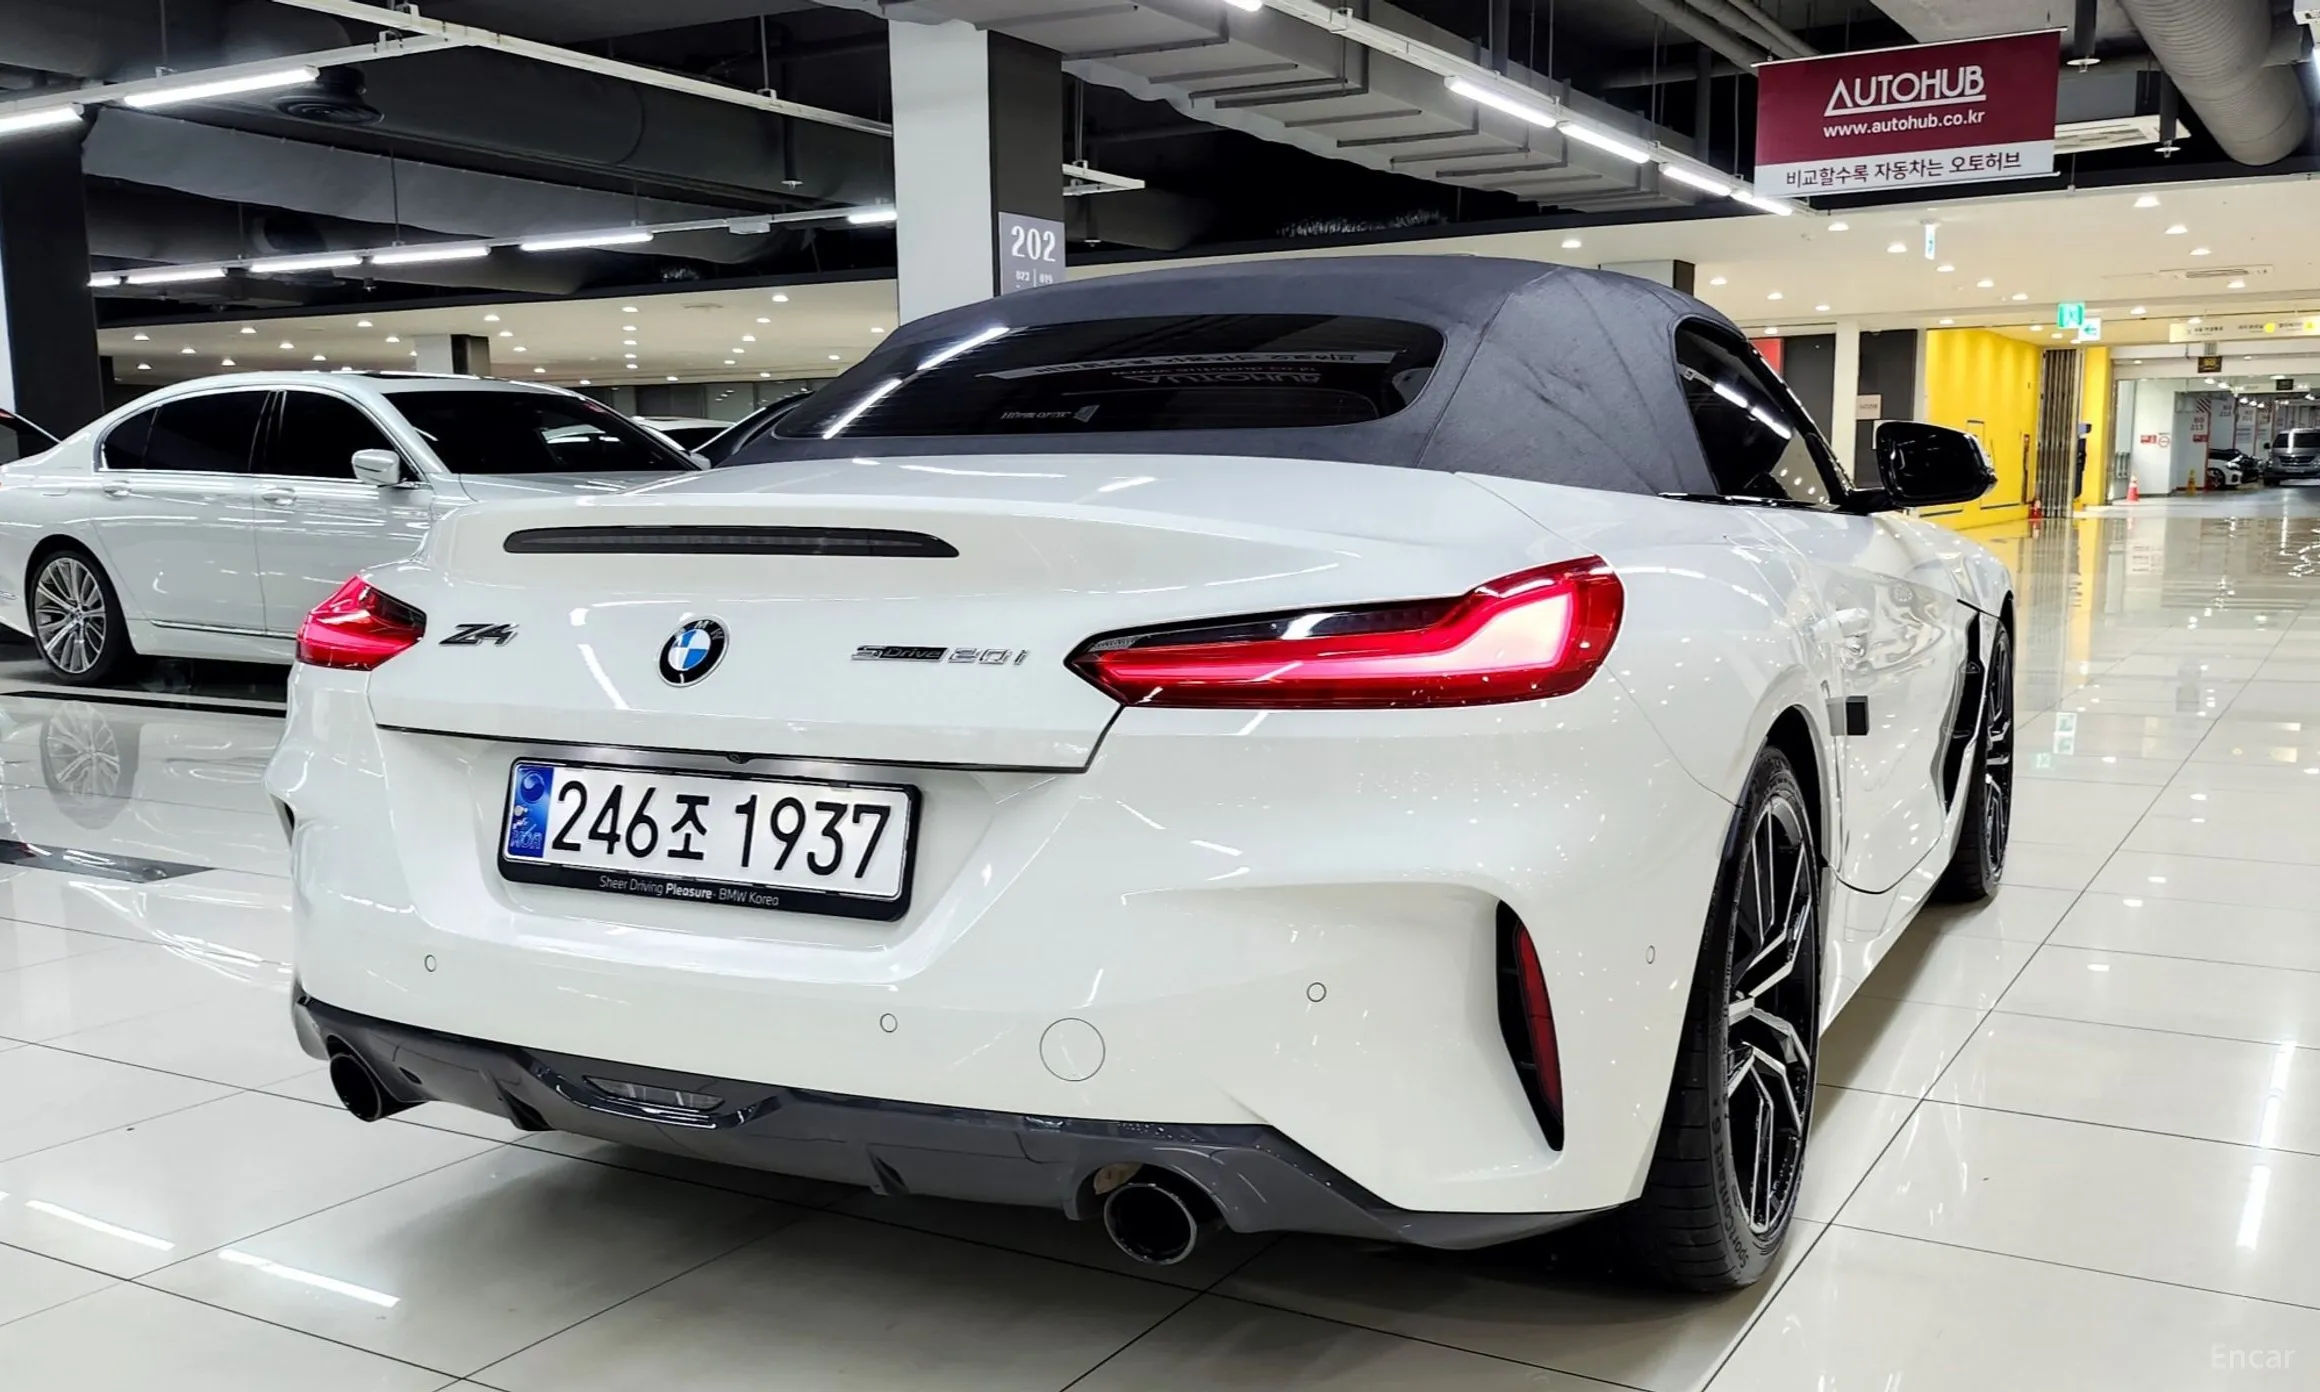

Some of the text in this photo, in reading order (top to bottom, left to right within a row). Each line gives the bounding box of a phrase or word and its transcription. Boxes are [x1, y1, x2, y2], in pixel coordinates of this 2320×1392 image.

[1824, 65, 1986, 117] AUTOHUB
[1823, 109, 1985, 138] www.autohub.co.kr
[1787, 152, 2021, 188] 비교할수록 자동차는 오토허브
[1011, 225, 1056, 262] 202
[439, 623, 519, 646] Z4
[552, 780, 891, 879] 246조 1937
[600, 875, 779, 906] Sheer Driving Pleasure BMW Korea
